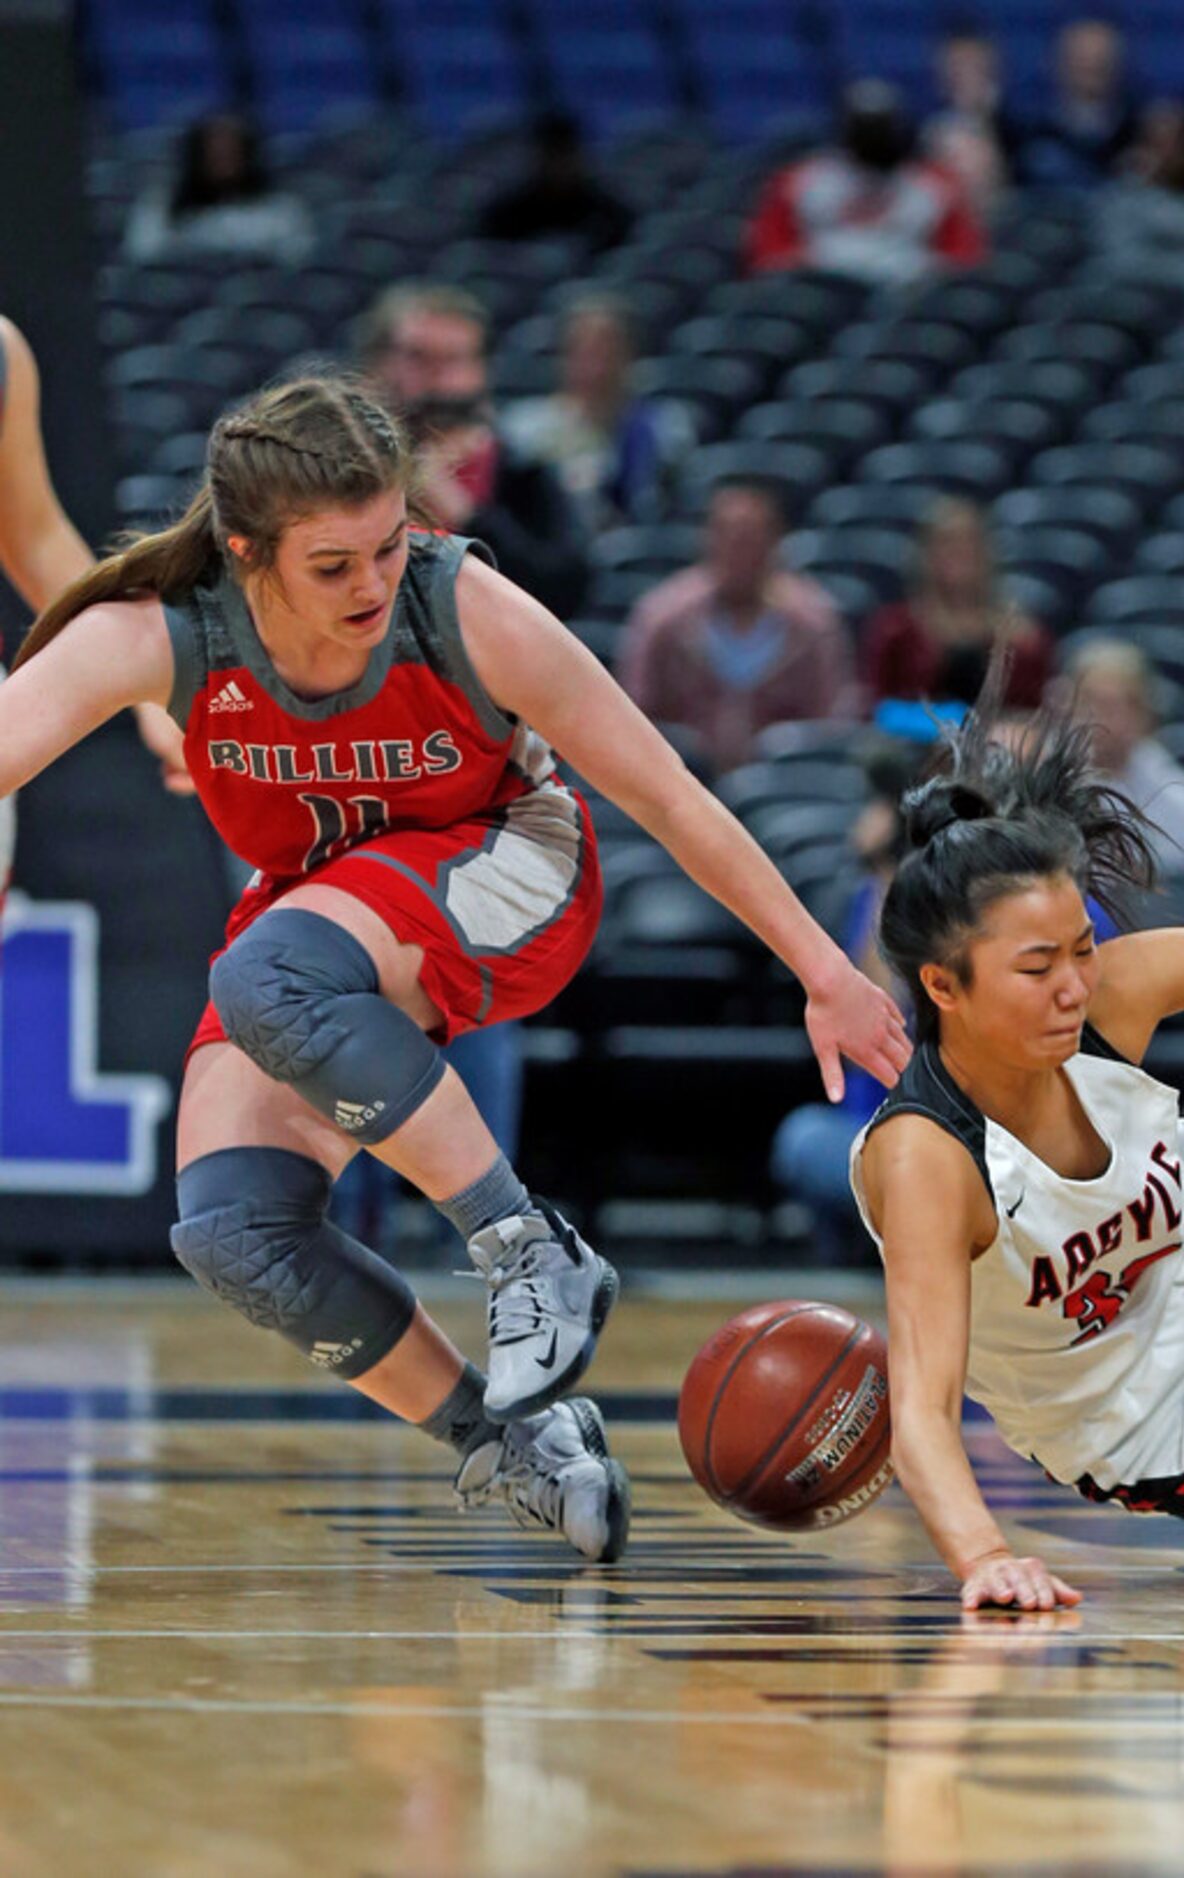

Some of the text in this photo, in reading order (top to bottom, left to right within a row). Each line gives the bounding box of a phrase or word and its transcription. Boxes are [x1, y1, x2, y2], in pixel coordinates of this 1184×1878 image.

[208, 730, 463, 784] BILLIES
[1062, 1241, 1184, 1345] 3
[822, 1373, 888, 1473] PLATINUM
